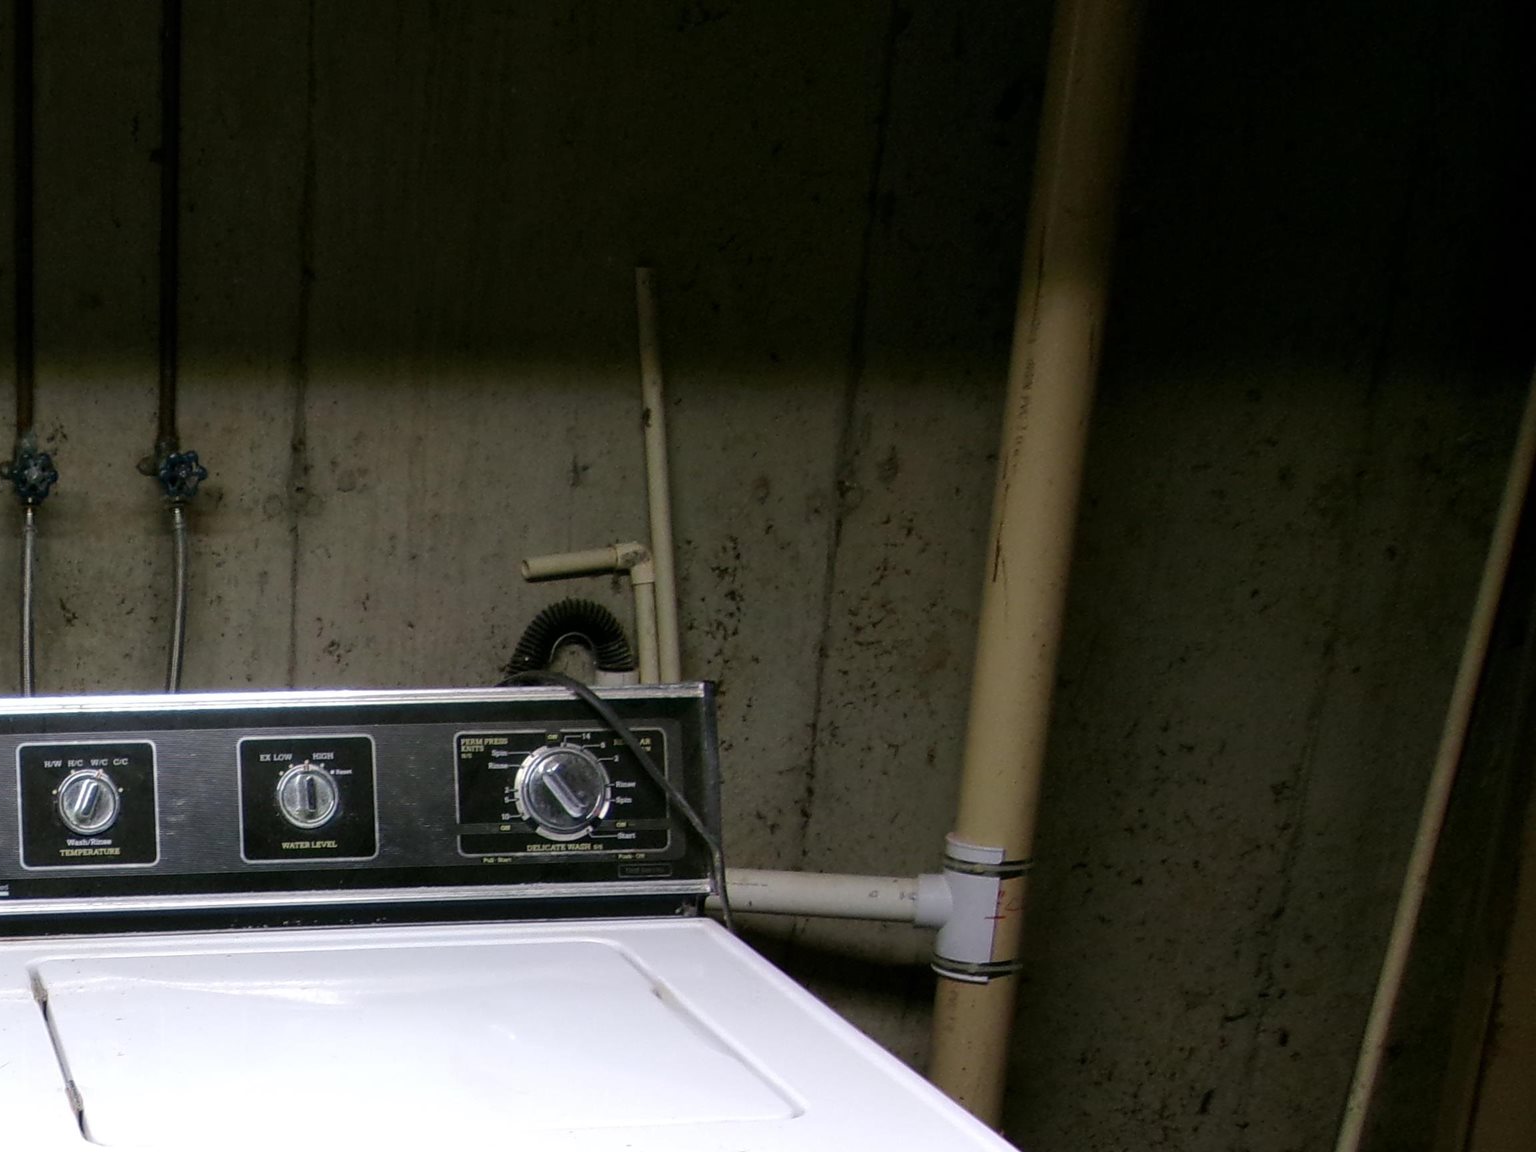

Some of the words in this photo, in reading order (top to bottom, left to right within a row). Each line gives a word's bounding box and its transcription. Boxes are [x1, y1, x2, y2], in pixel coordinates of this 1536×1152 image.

[460, 738, 483, 746] PERM
[273, 753, 292, 761] LOW
[312, 752, 334, 760] HIGH
[44, 760, 62, 768] H/W
[90, 759, 108, 767] W/C
[112, 758, 128, 766] C/C
[617, 832, 636, 840] Start
[66, 838, 112, 846] Wash/Rinse
[311, 840, 338, 848] LEVEL
[526, 844, 566, 852] DELICATE
[567, 843, 591, 851] WASH
[59, 847, 121, 857] TEMPERATURE
